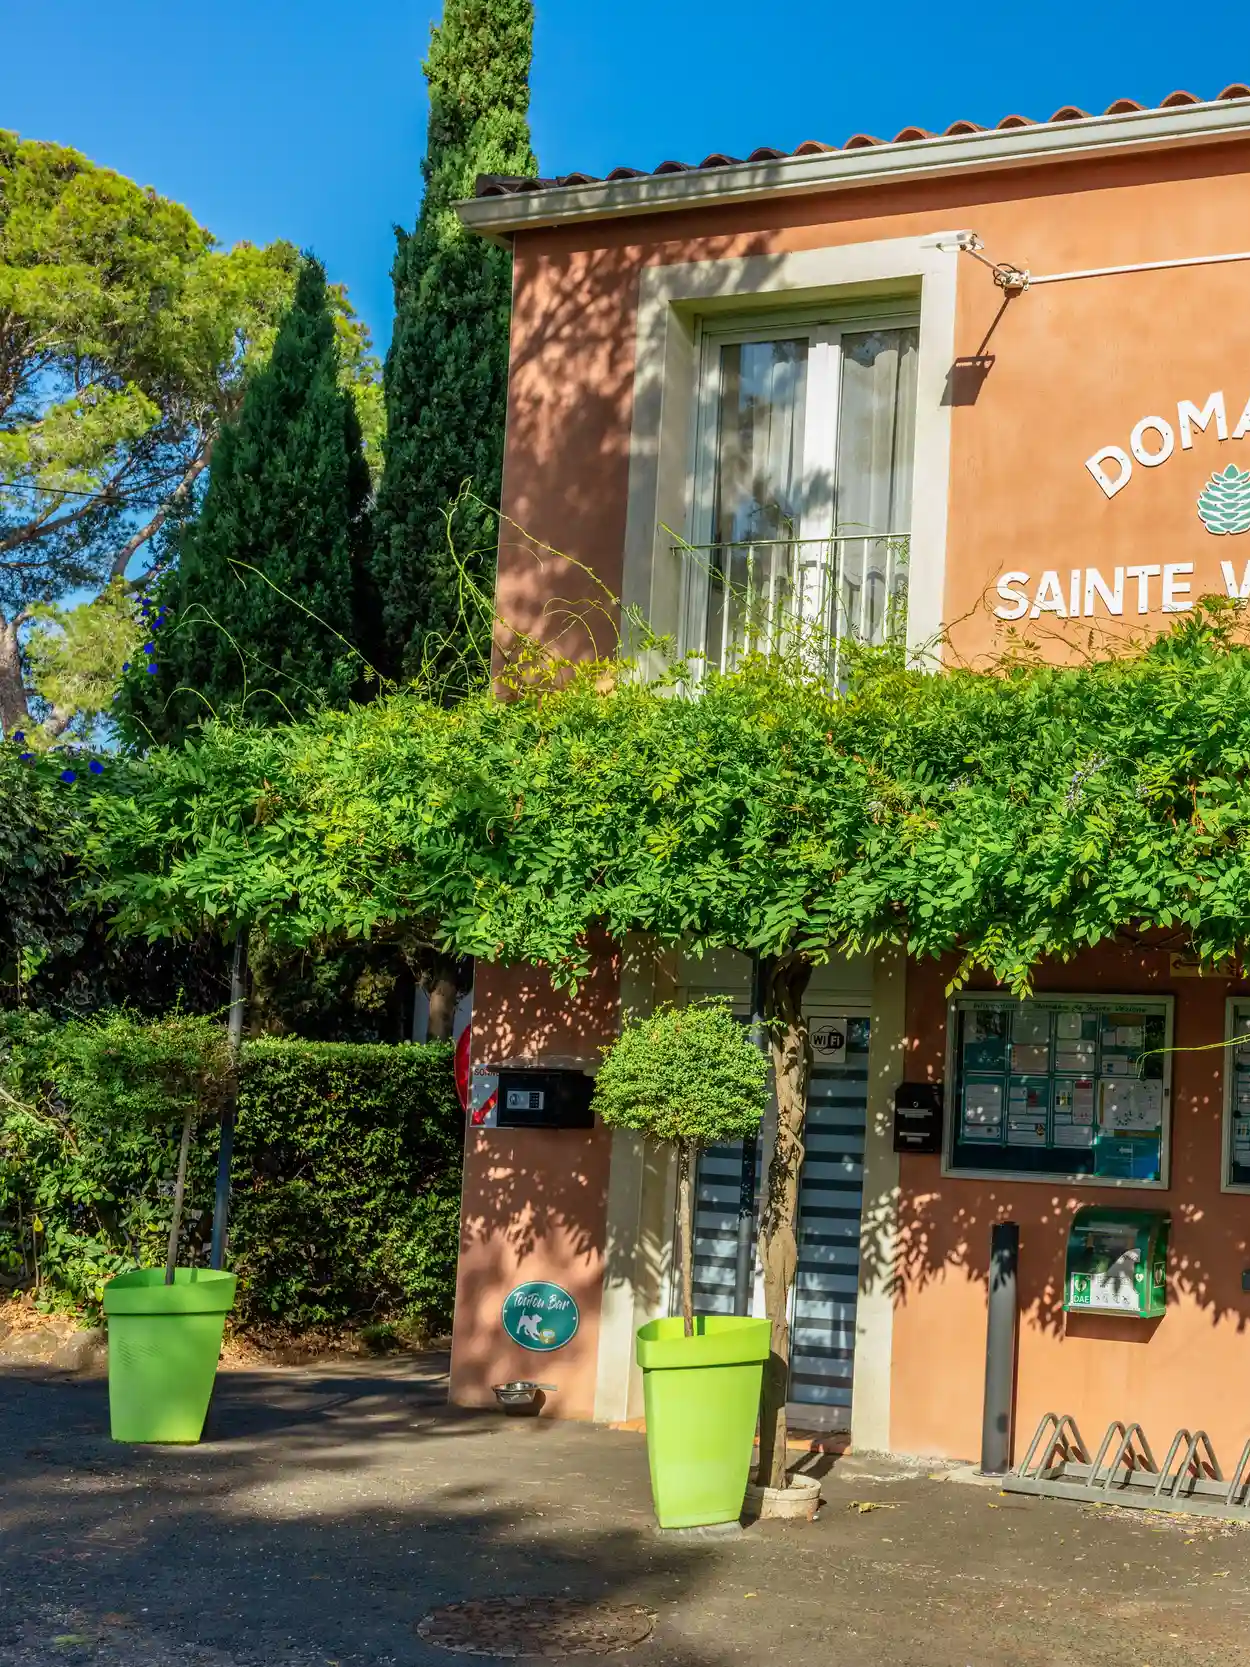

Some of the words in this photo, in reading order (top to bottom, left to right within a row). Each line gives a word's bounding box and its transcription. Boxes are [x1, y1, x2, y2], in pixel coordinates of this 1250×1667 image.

[992, 561, 1196, 621] SAINTE
[547, 1293, 570, 1312] Bar
[1073, 1295, 1090, 1303] DAE
